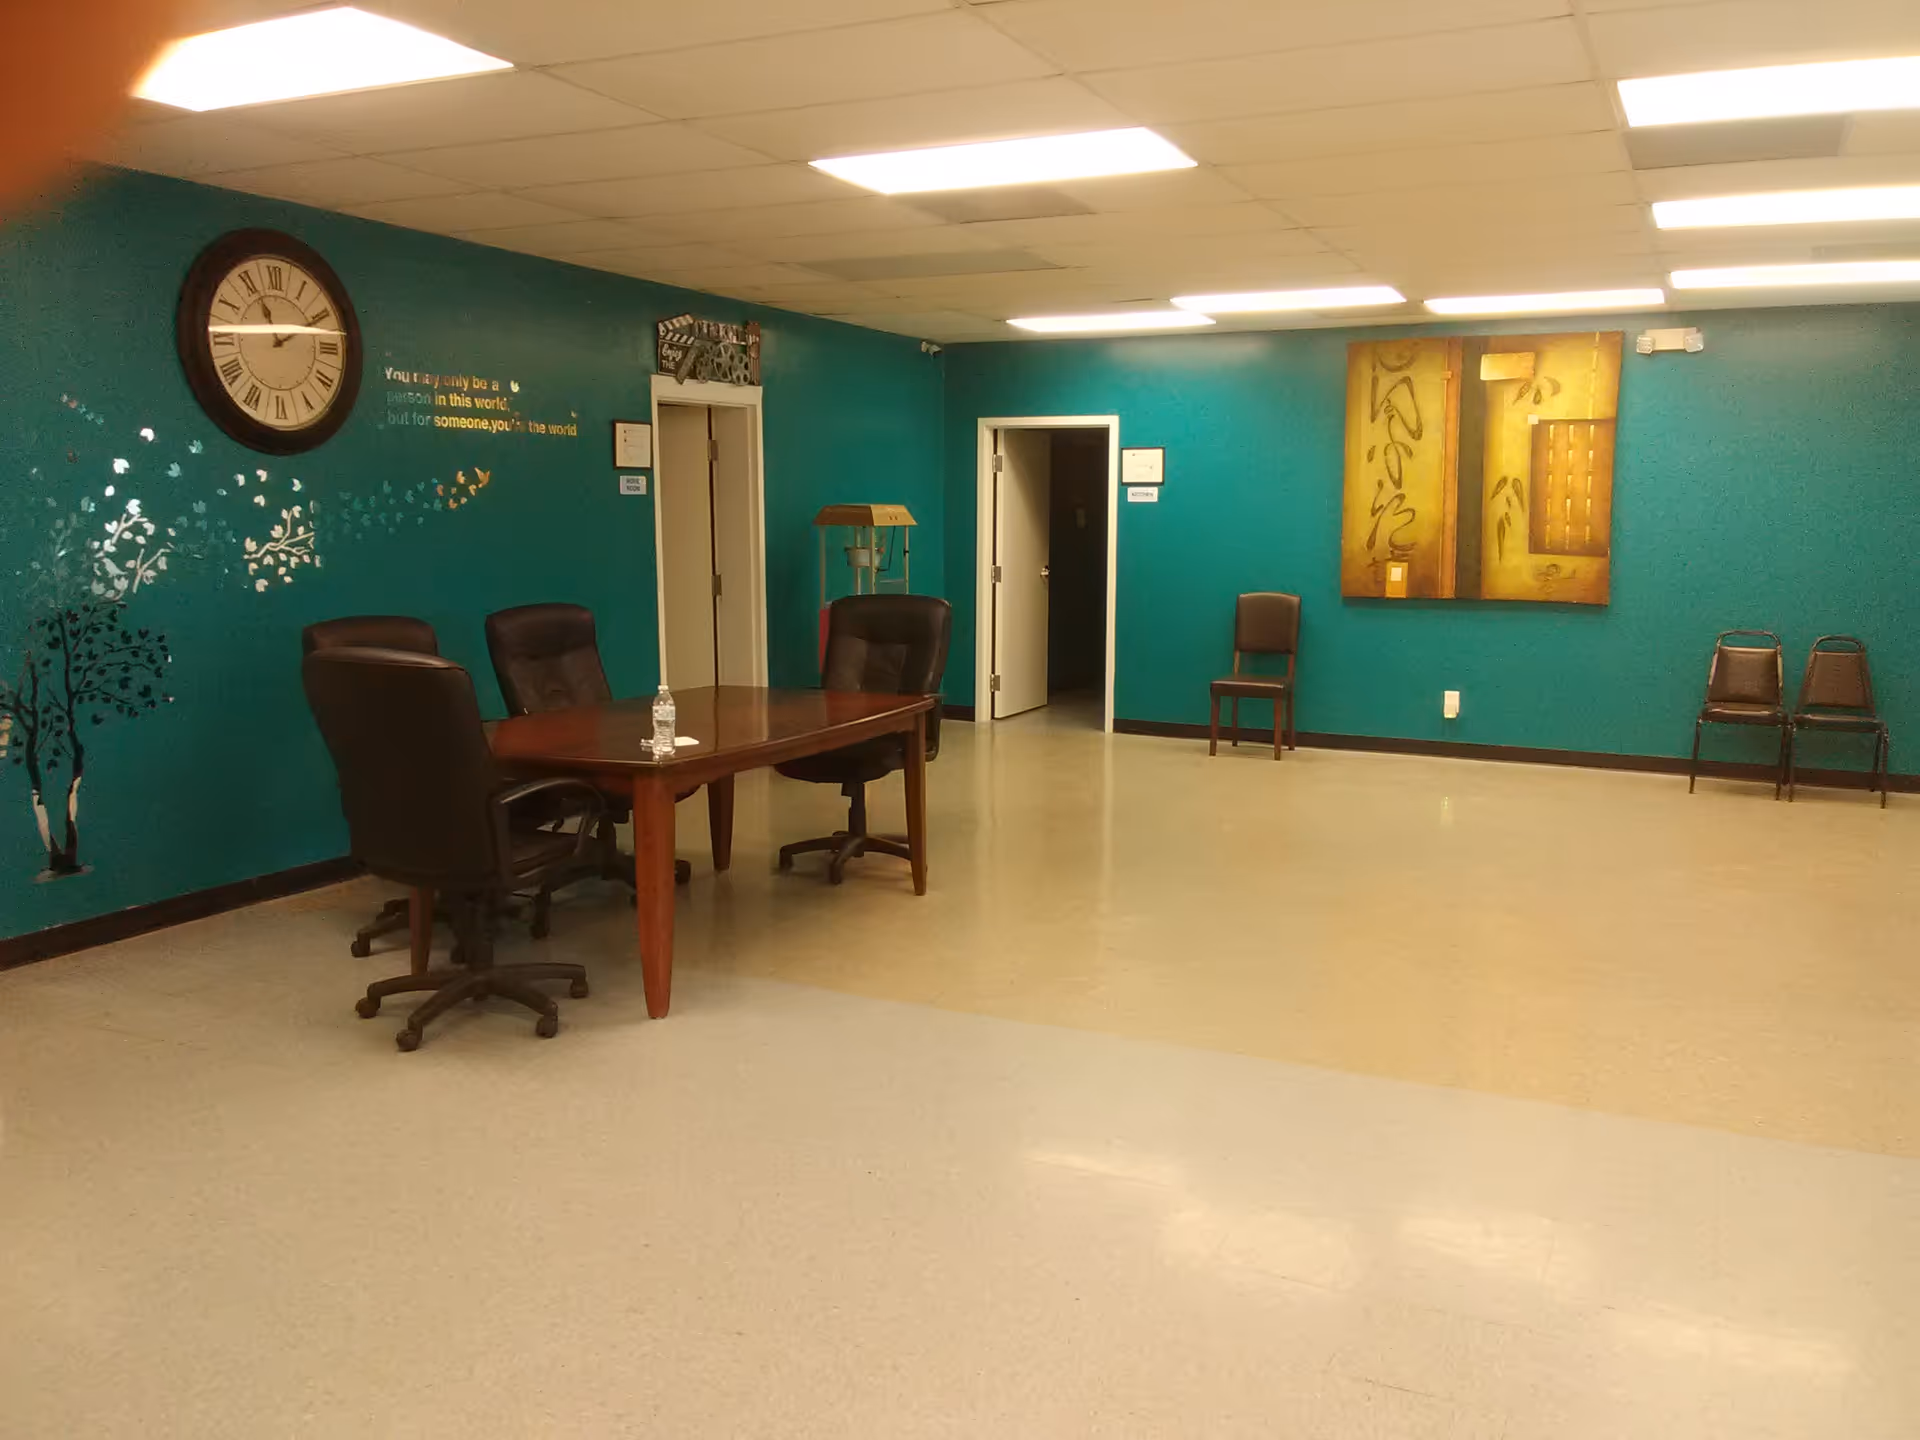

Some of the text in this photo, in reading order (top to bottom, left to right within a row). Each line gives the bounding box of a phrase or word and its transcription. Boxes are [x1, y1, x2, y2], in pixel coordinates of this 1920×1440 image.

[385, 367, 410, 384] You
[441, 373, 469, 391] only
[472, 375, 488, 390] be
[492, 379, 499, 391] a
[434, 391, 446, 405] in
[448, 392, 472, 408] this
[387, 408, 409, 425] but
[412, 411, 431, 426] for
[528, 420, 546, 434] the
[548, 423, 577, 437] world
